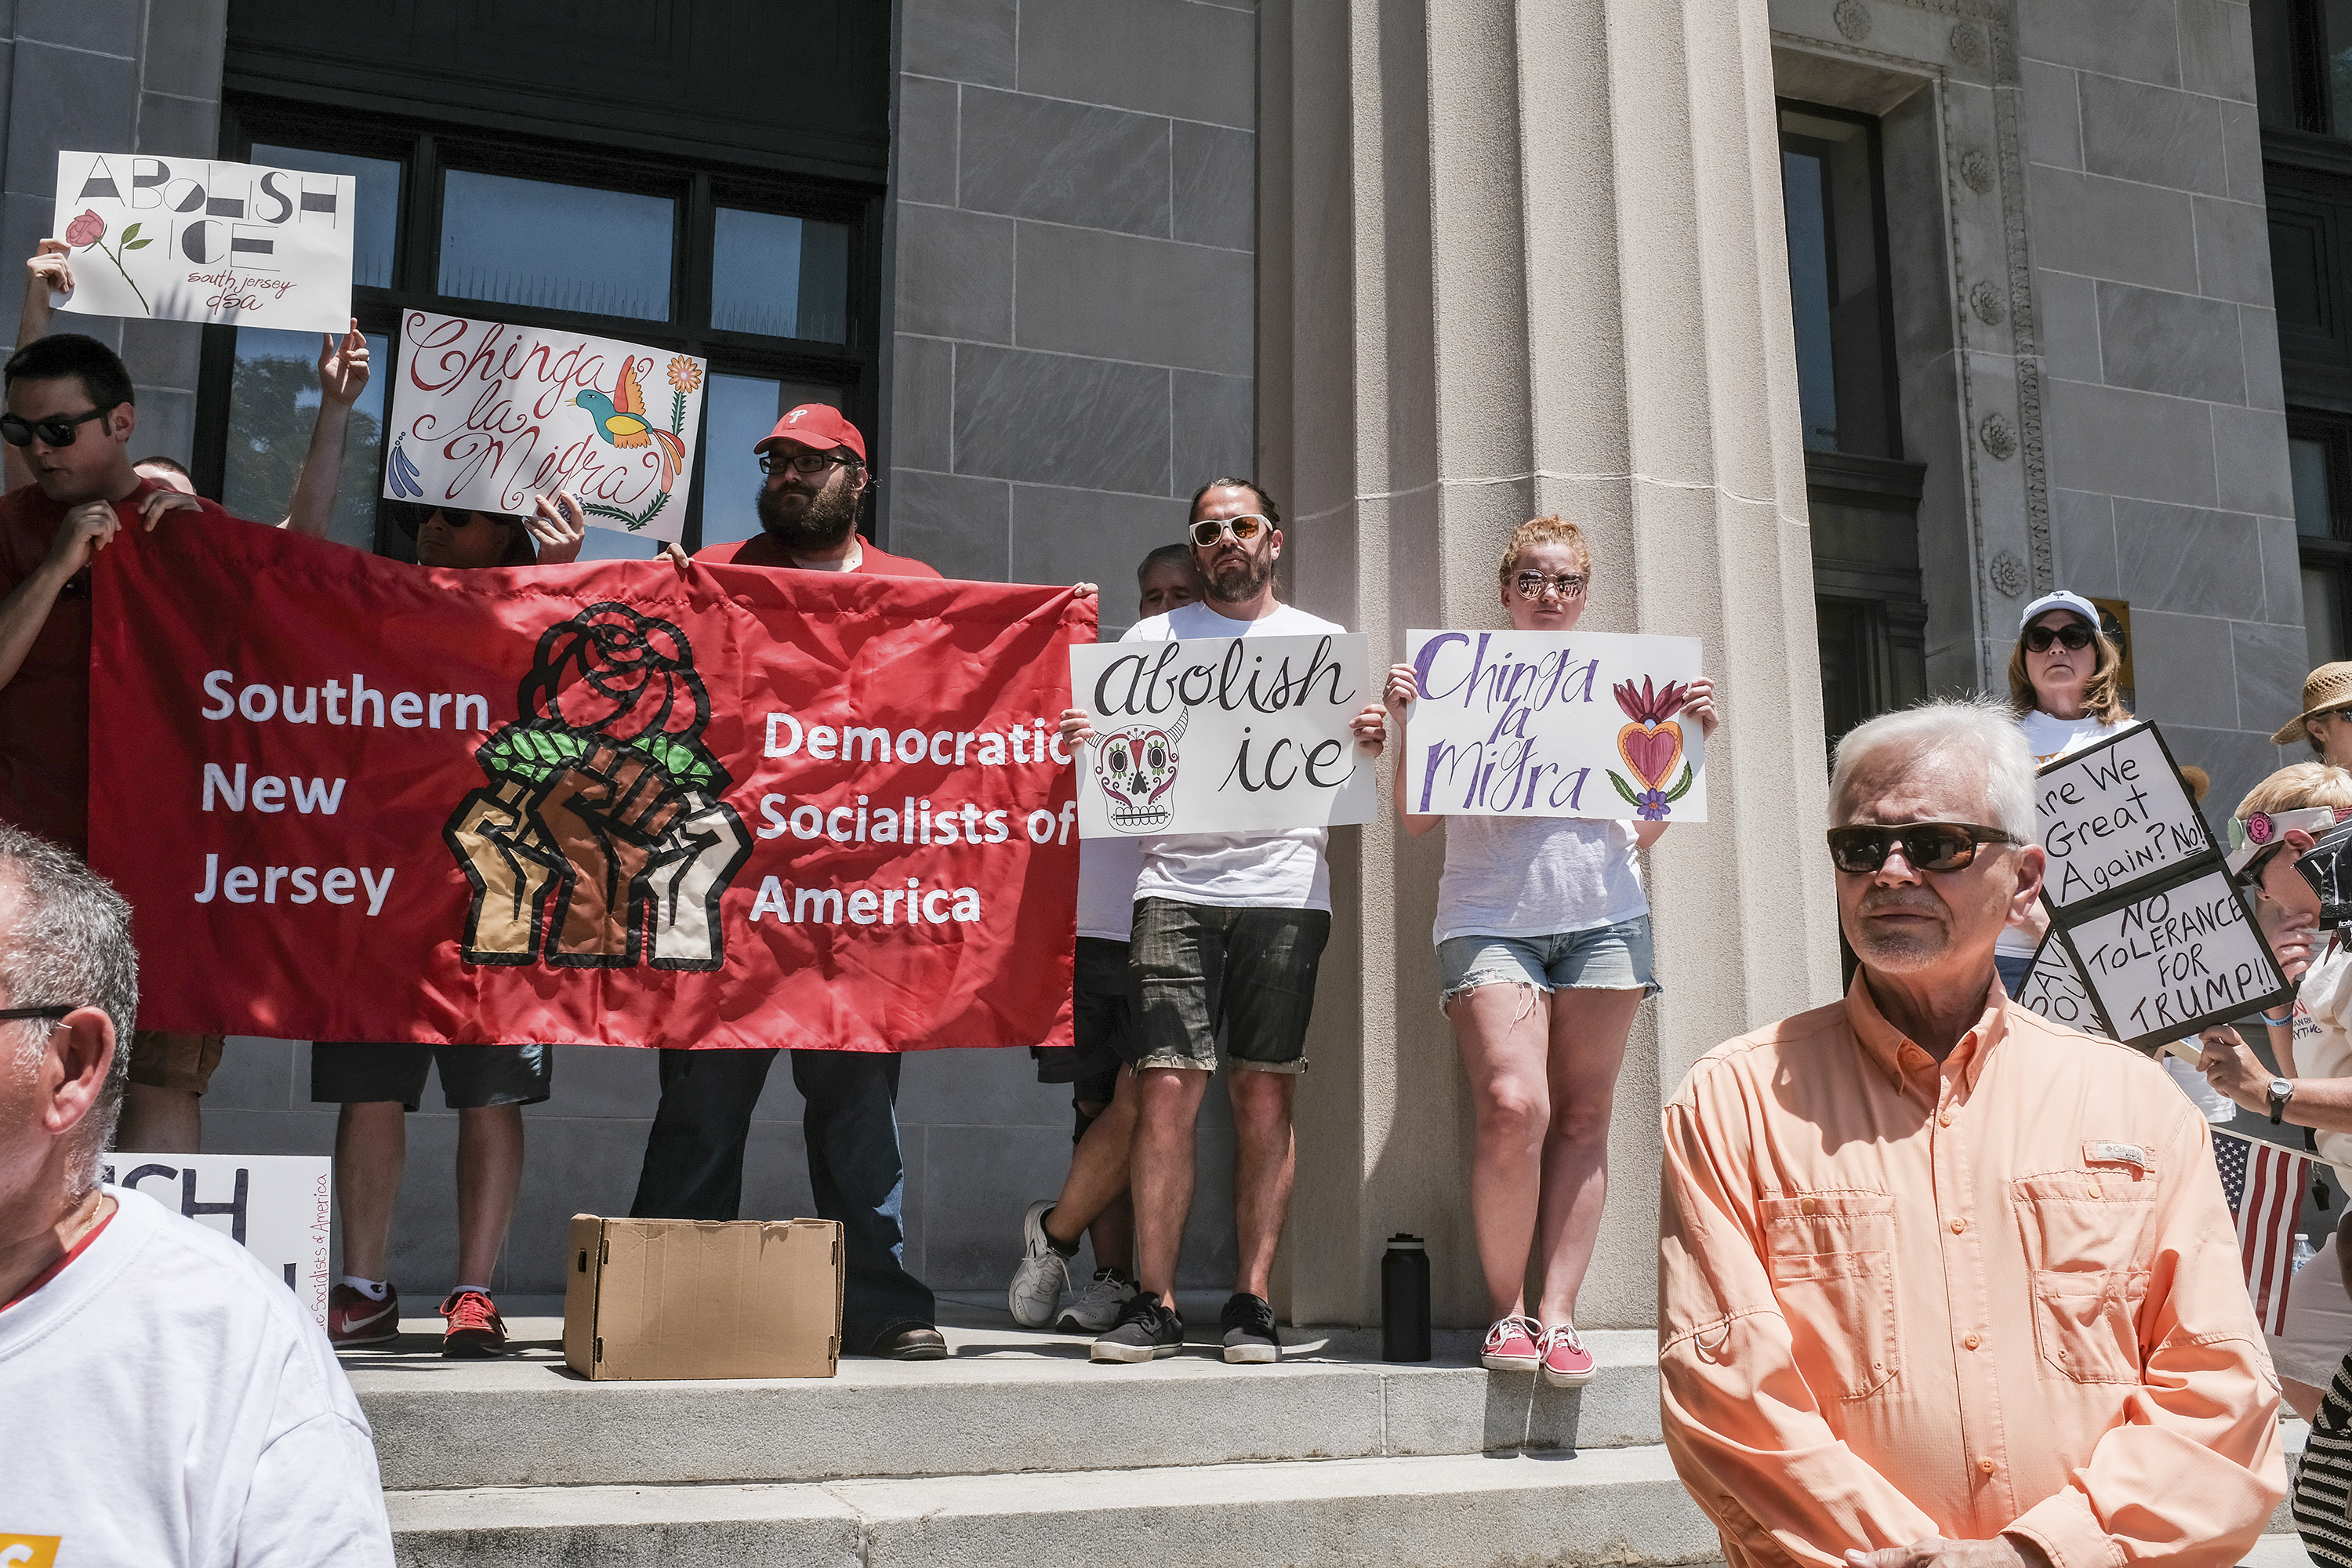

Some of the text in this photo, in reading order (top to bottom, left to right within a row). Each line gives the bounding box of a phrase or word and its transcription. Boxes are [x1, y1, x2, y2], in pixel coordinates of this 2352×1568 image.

[75, 155, 339, 229] ABOLISH
[169, 220, 281, 272] ICE
[187, 270, 297, 299] south jersey
[205, 287, 264, 315] dsa
[406, 312, 616, 419] Chinga
[412, 379, 528, 441] la
[443, 426, 660, 517] Migra
[201, 670, 489, 731] Southern
[1414, 632, 1600, 713] Chinga
[764, 712, 1073, 766] Democratic
[1485, 695, 1532, 746] la
[201, 763, 347, 815] New
[1218, 726, 1357, 793] ice
[1418, 735, 1592, 813] Migra
[2037, 782, 2085, 818] re
[2080, 745, 2140, 792] We
[756, 793, 1076, 846] Socialists of
[2045, 784, 2149, 858] Great
[194, 853, 395, 916] Jersey
[749, 875, 981, 925] America
[2121, 892, 2170, 938] NO
[2021, 929, 2064, 1018] SAV
[2129, 957, 2274, 1033] TRUMP!!
[2157, 942, 2211, 988] FOR
[310, 1174, 331, 1232] America
[308, 1247, 330, 1312] Socialists
